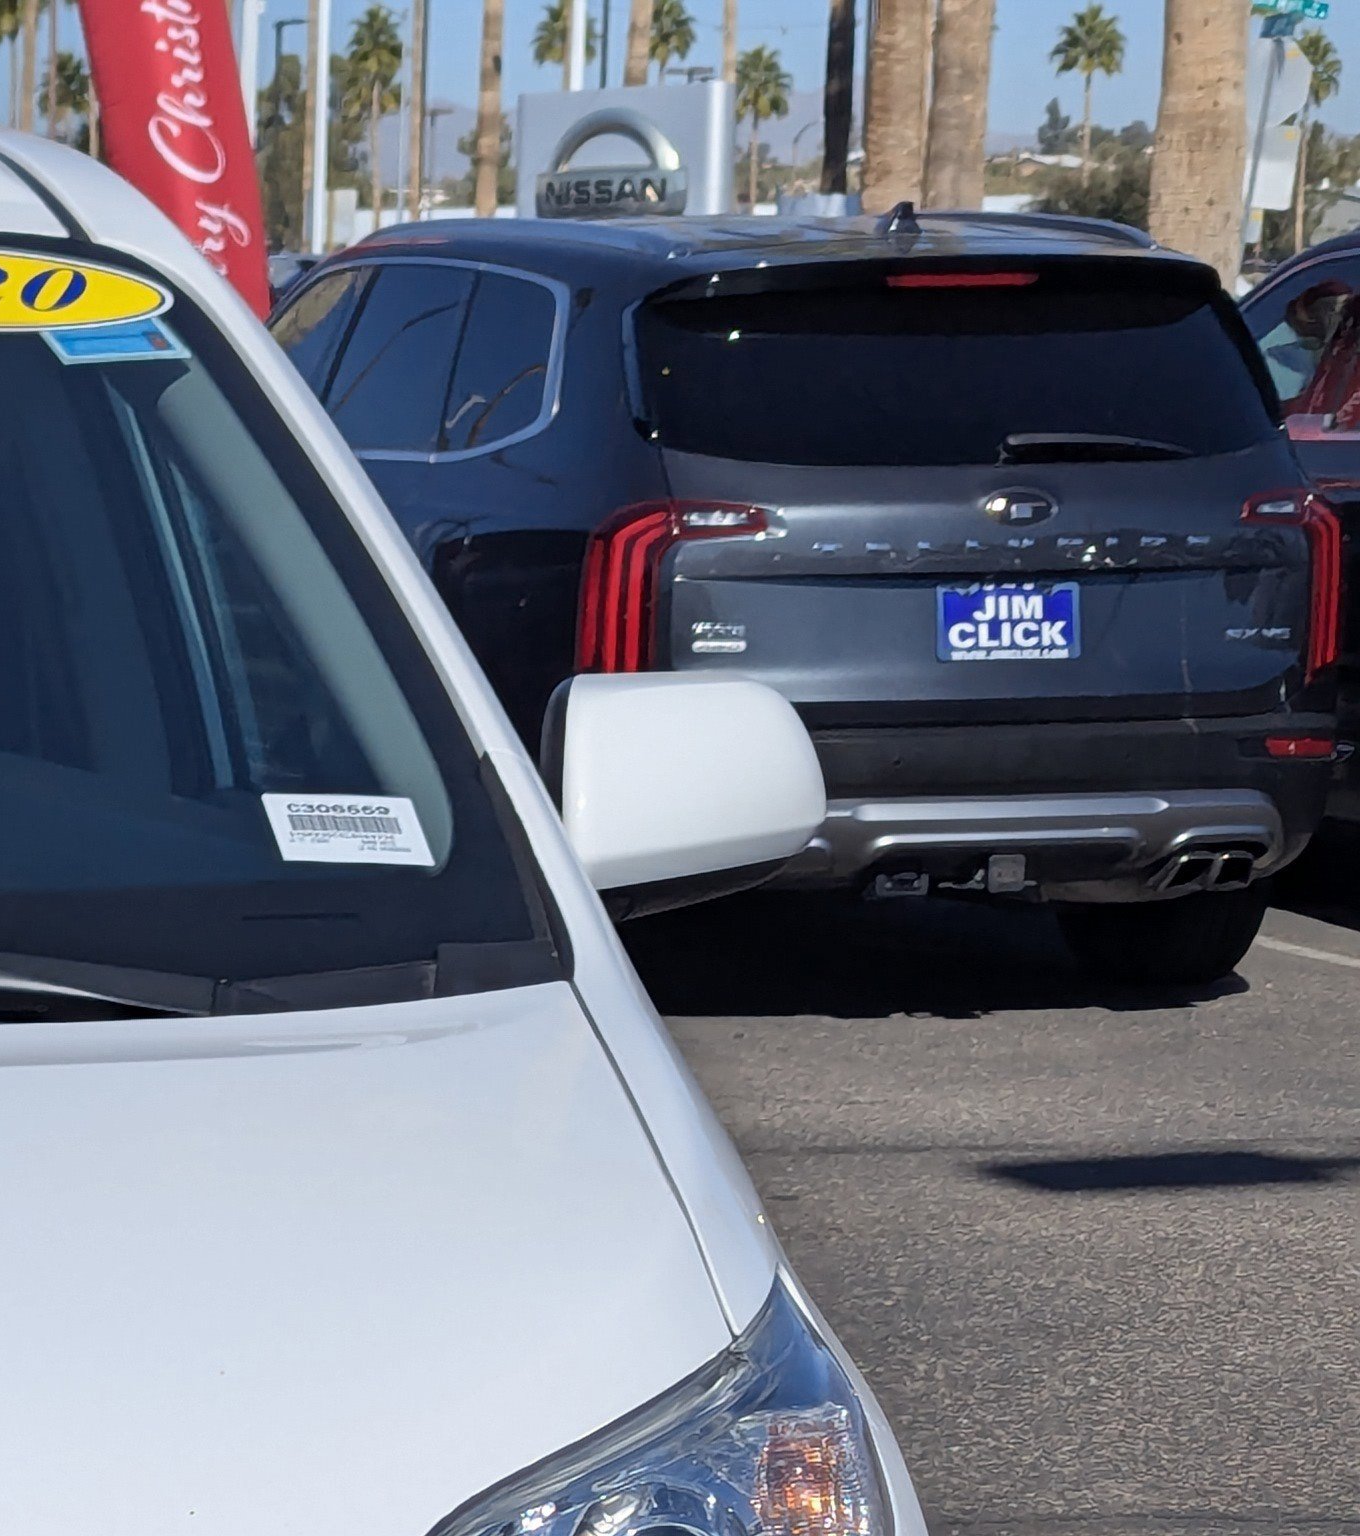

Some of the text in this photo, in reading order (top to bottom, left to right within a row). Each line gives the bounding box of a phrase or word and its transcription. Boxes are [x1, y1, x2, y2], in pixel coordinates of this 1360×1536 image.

[545, 177, 668, 205] NISSAN
[972, 594, 1044, 621] JIM
[947, 620, 1068, 649] CLICK
